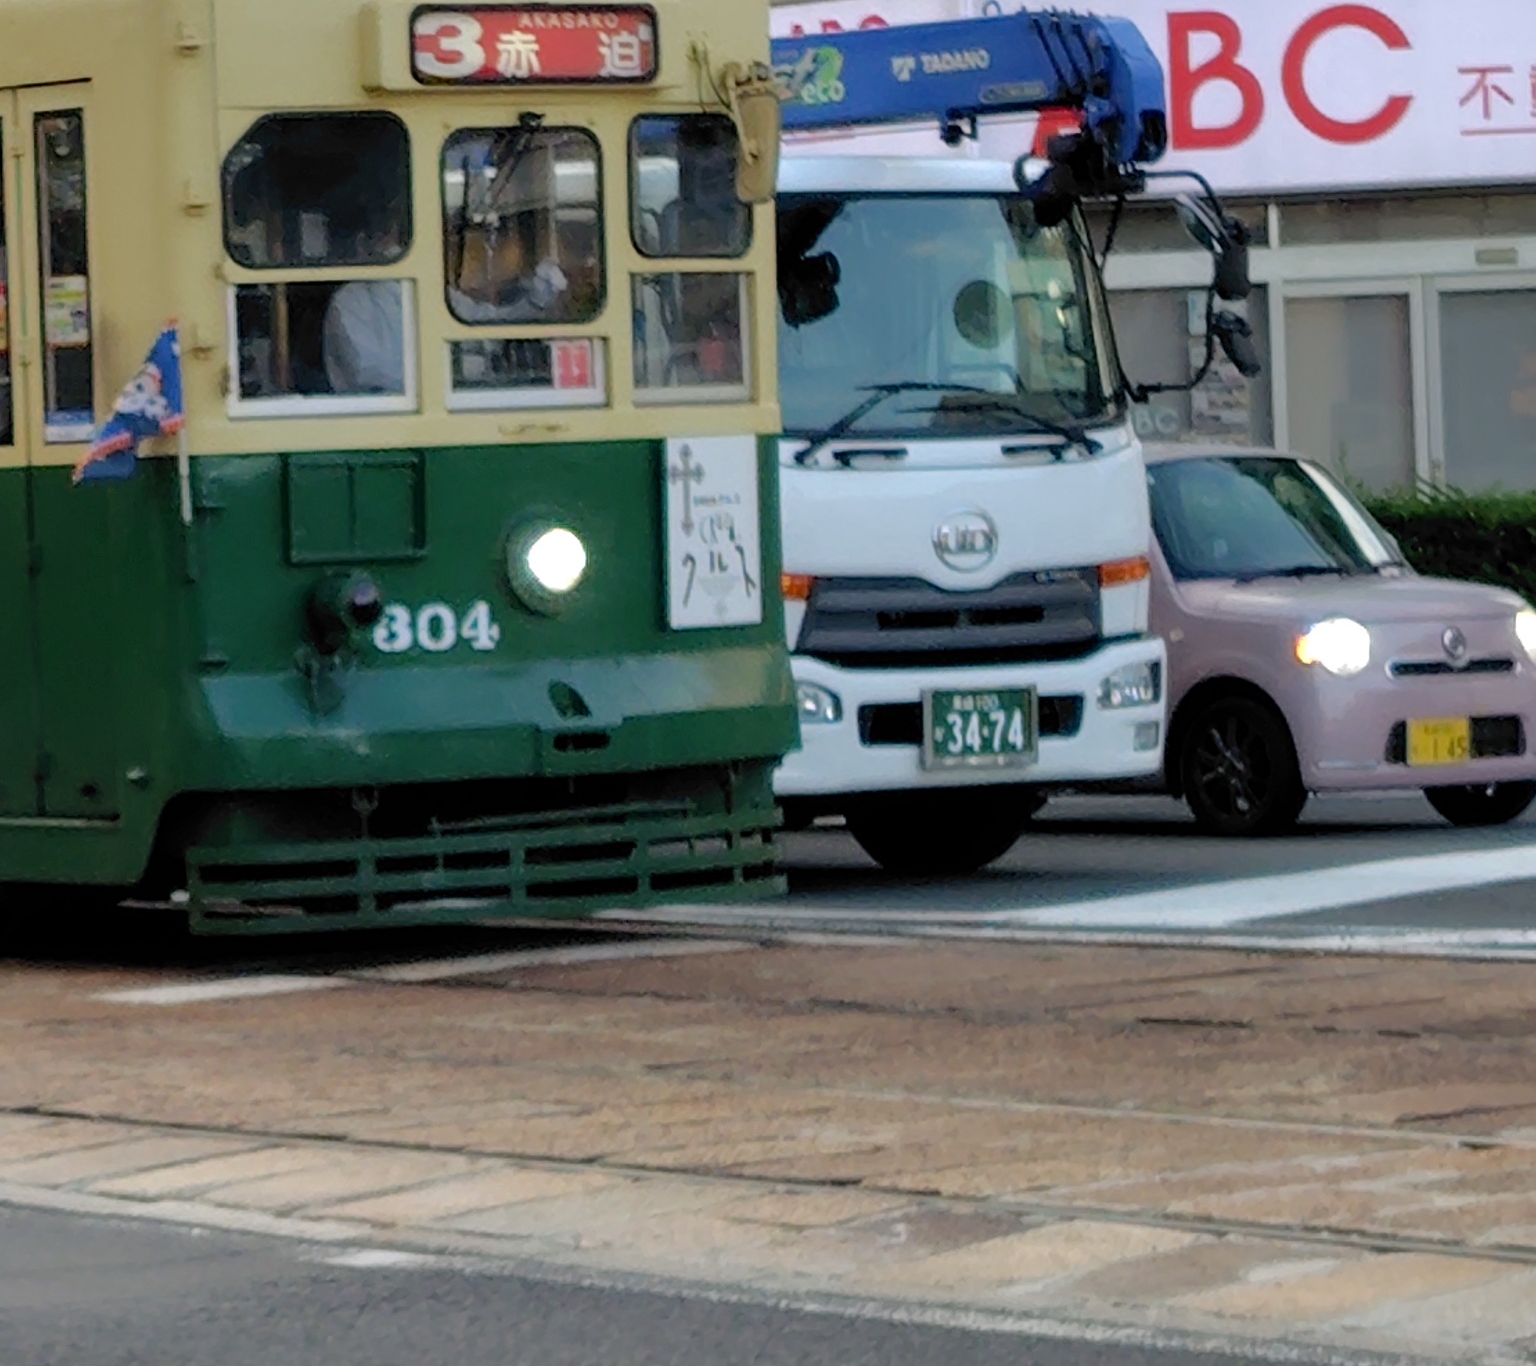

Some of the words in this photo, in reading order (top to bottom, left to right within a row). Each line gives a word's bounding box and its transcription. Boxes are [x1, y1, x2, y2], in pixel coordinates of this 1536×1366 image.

[413, 11, 486, 79] 3
[496, 30, 641, 78] 赤迫
[517, 11, 619, 30] AKASAKO
[920, 48, 990, 74] TADANO
[1032, 3, 1415, 156] BC
[801, 81, 845, 105] eco
[1457, 63, 1536, 121] 不
[372, 599, 500, 653] 304
